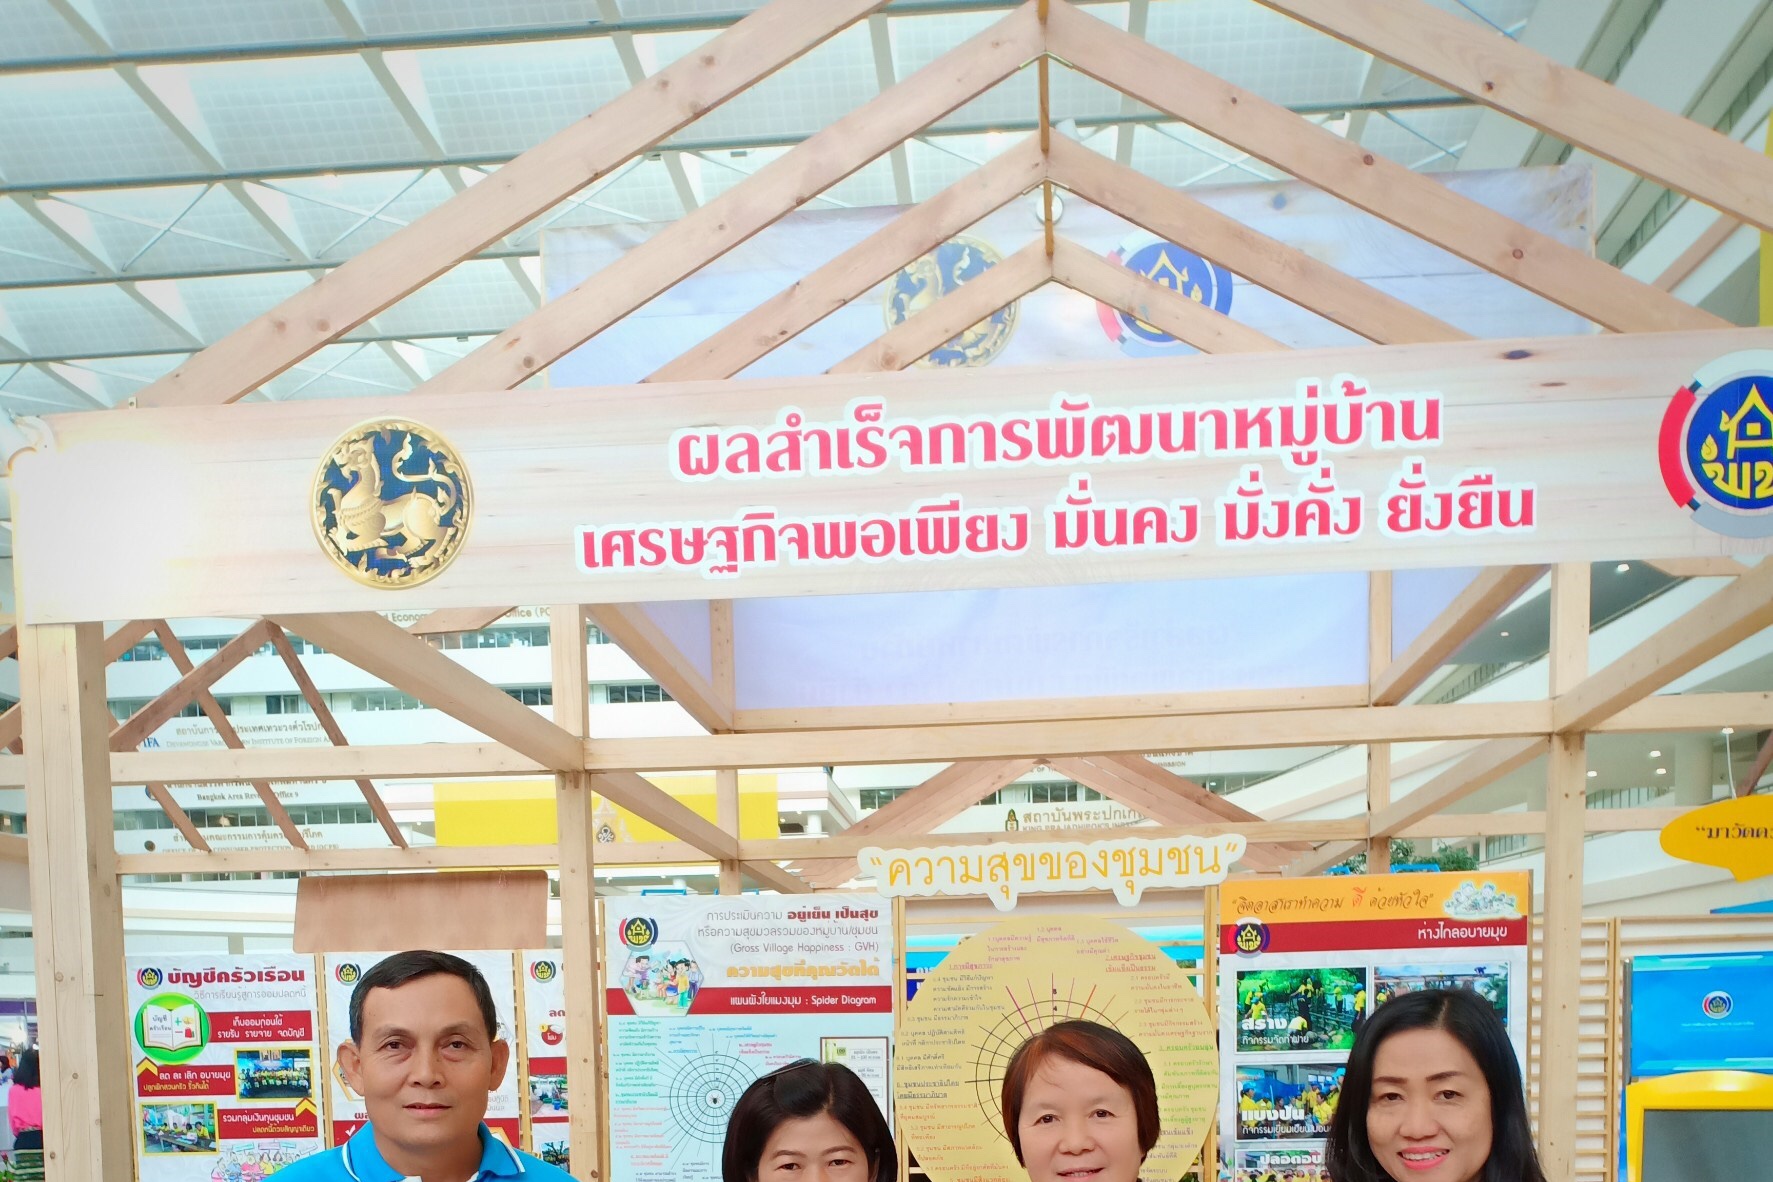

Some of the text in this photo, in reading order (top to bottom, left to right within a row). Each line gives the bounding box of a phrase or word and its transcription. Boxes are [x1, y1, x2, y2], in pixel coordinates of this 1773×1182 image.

[678, 381, 1442, 477] ผลสำเร็จการพัฒนาหมู่บ้าน
[582, 461, 1535, 573] เศรษฐกิจพอเพียง มั่นคง มั่งคั่ง ยั่งยืน
[197, 794, 225, 802] Bangkok
[870, 842, 1238, 900] “ความสุขของชุมชน”
[1353, 887, 1366, 909] ดี
[707, 905, 878, 922] การประเมินความ อยู่เย็น เป็นสุข
[1418, 921, 1507, 945] ห่างไกลอบายมุข
[730, 943, 759, 953] (Gross
[763, 942, 794, 954] Village
[798, 942, 844, 954] Happiness
[855, 942, 879, 953] GVH)
[168, 967, 305, 988] บัญชีครัวเรือน
[727, 957, 880, 980] ความสุขที่คุณวัดได้
[730, 991, 801, 1008] แผนผังใยแมงมุม
[811, 995, 838, 1008] Spider
[842, 995, 876, 1006] Diagram
[233, 1014, 283, 1028] เก็บออมก่อนใช้
[218, 1029, 240, 1038] รายรับ
[278, 1028, 305, 1038] จดบัญชี
[173, 1072, 182, 1080] ละ
[184, 1070, 197, 1080] เลิก
[200, 1072, 231, 1082] อบายมุข
